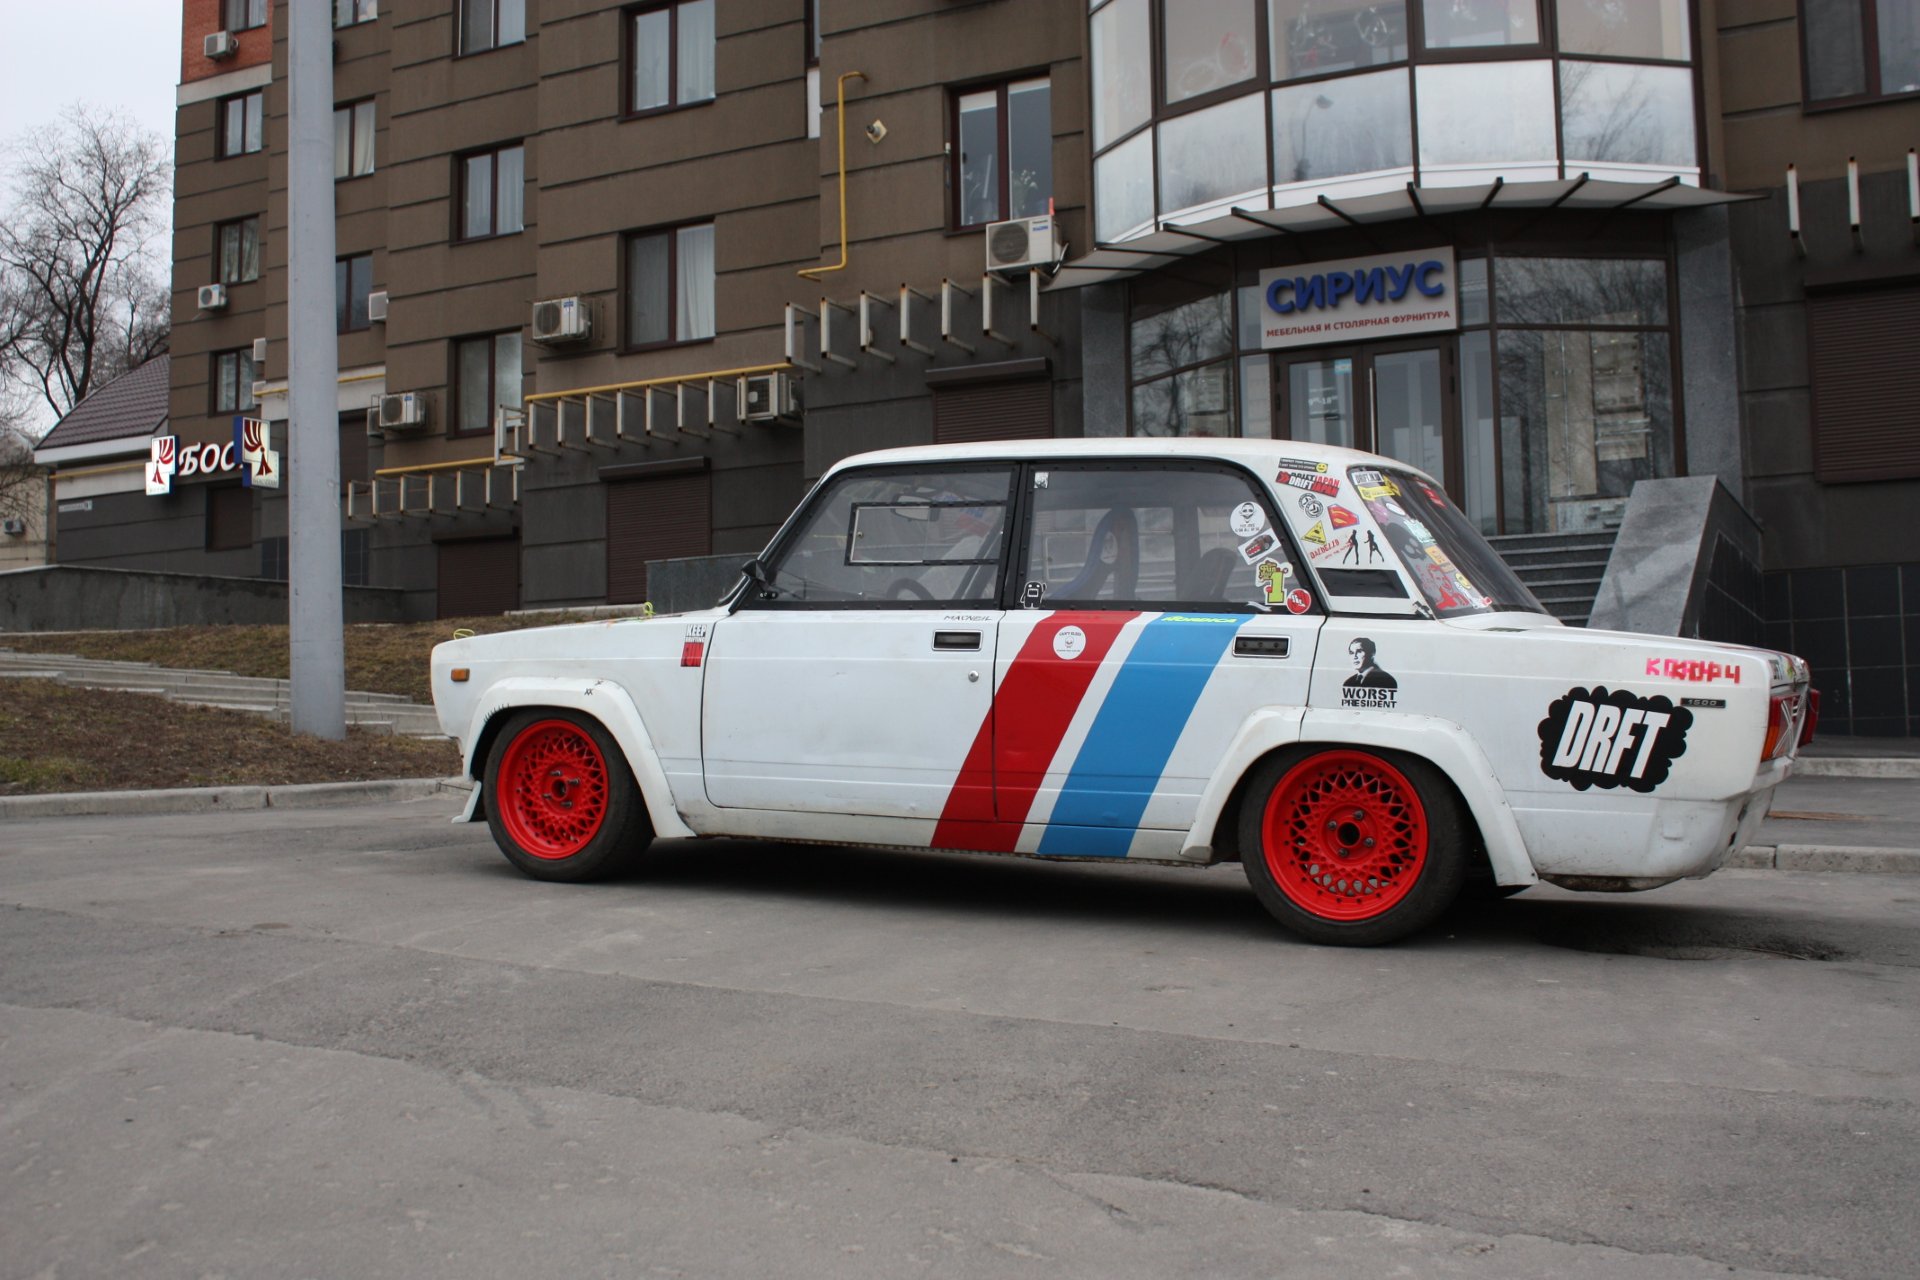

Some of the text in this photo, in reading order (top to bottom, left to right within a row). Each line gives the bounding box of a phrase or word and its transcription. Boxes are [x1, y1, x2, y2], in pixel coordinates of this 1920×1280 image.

[1265, 260, 1446, 314] СИРИУС
[1266, 310, 1451, 338] МЕБЕЛЬНАЯ И СТОЛЯРНАЯ ФУРНИТУРА
[178, 441, 244, 476] БОС
[1288, 476, 1315, 490] DRIFT
[686, 624, 707, 637] KEEP
[1341, 699, 1397, 709] PRESIDENT
[1342, 687, 1398, 701] WORST
[1552, 700, 1671, 779] DRFT
